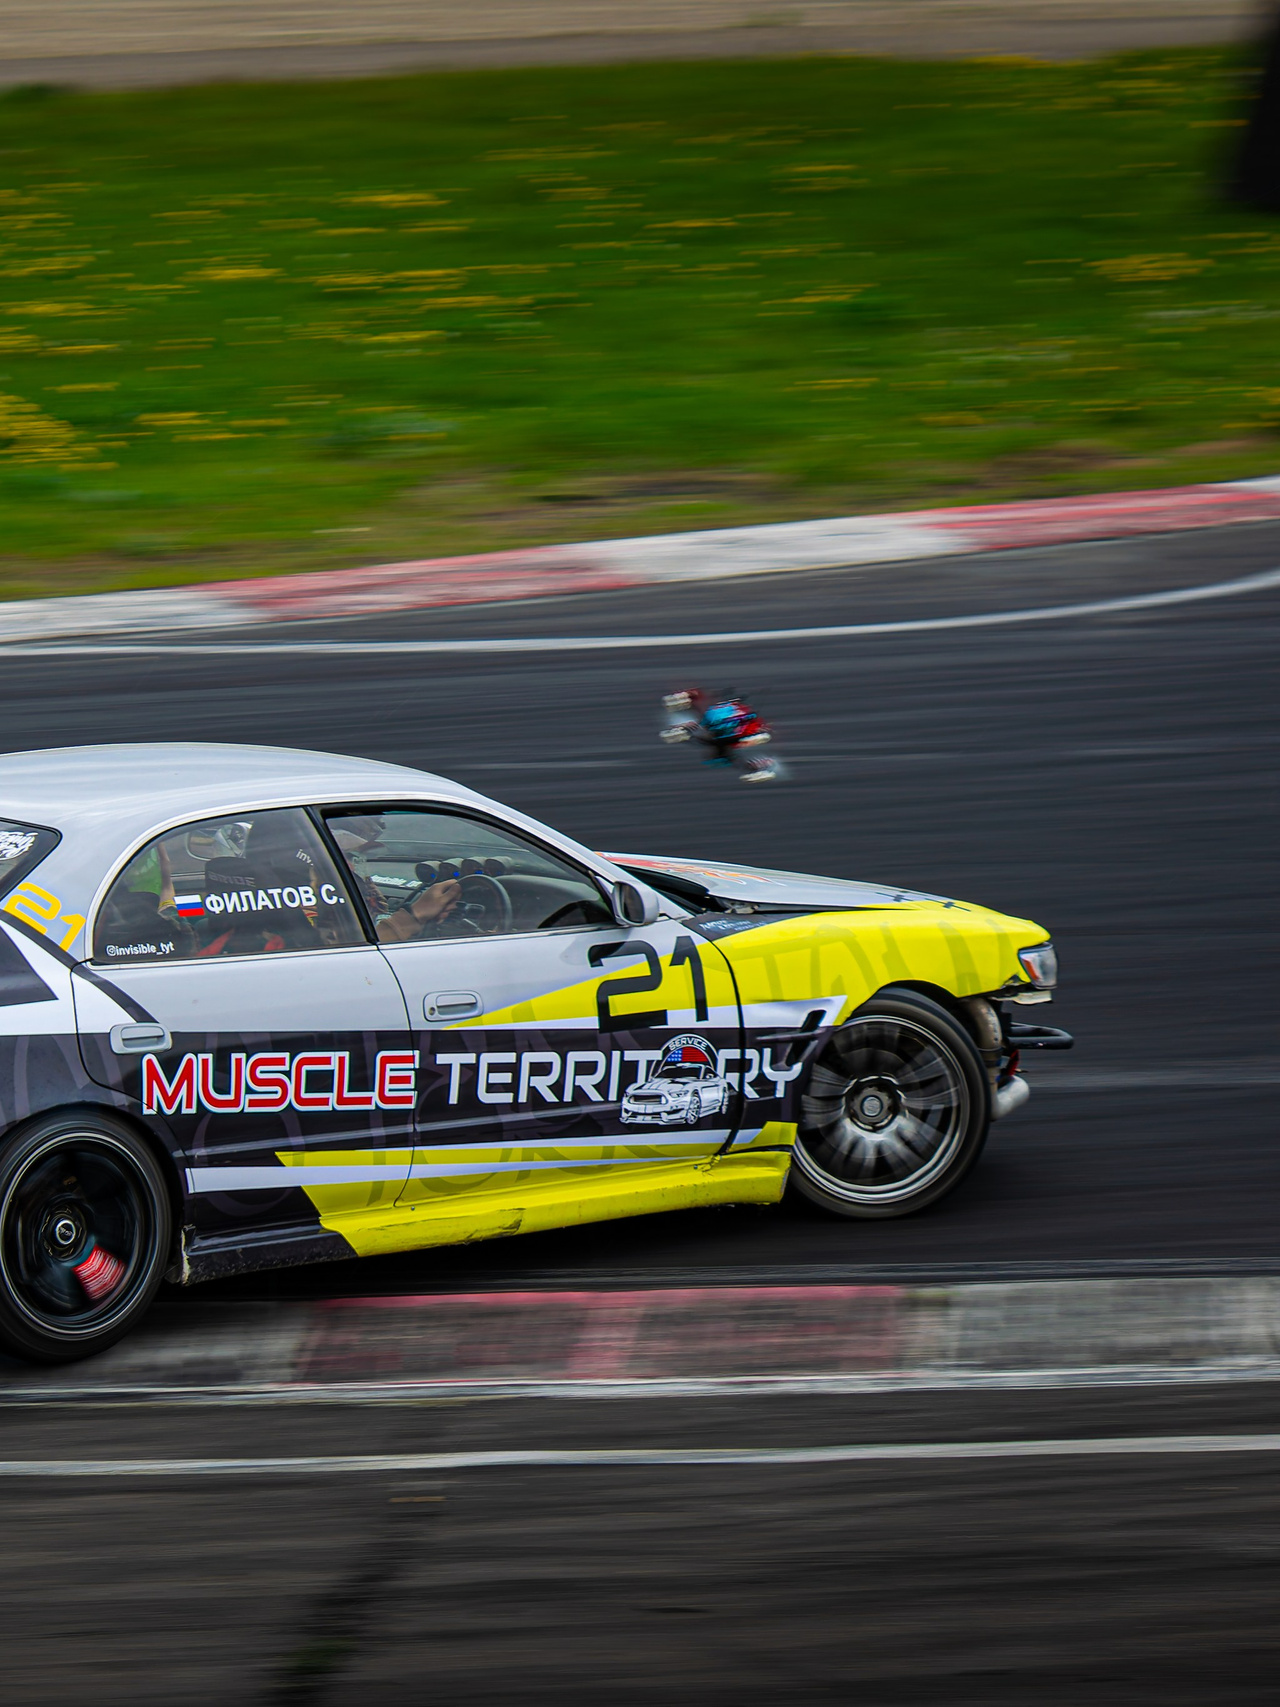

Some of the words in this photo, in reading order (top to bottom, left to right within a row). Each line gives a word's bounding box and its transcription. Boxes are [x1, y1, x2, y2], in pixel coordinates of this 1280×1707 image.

[3, 882, 87, 951] 21
[205, 885, 318, 914] ФИЛАТОВ
[320, 883, 345, 906] С.
[106, 941, 175, 957] @invisible_tyt
[588, 935, 709, 1033] 21
[668, 1037, 708, 1051] SERVICE
[142, 1050, 420, 1116] MUSCLE
[435, 1048, 803, 1106] TERRITRY
